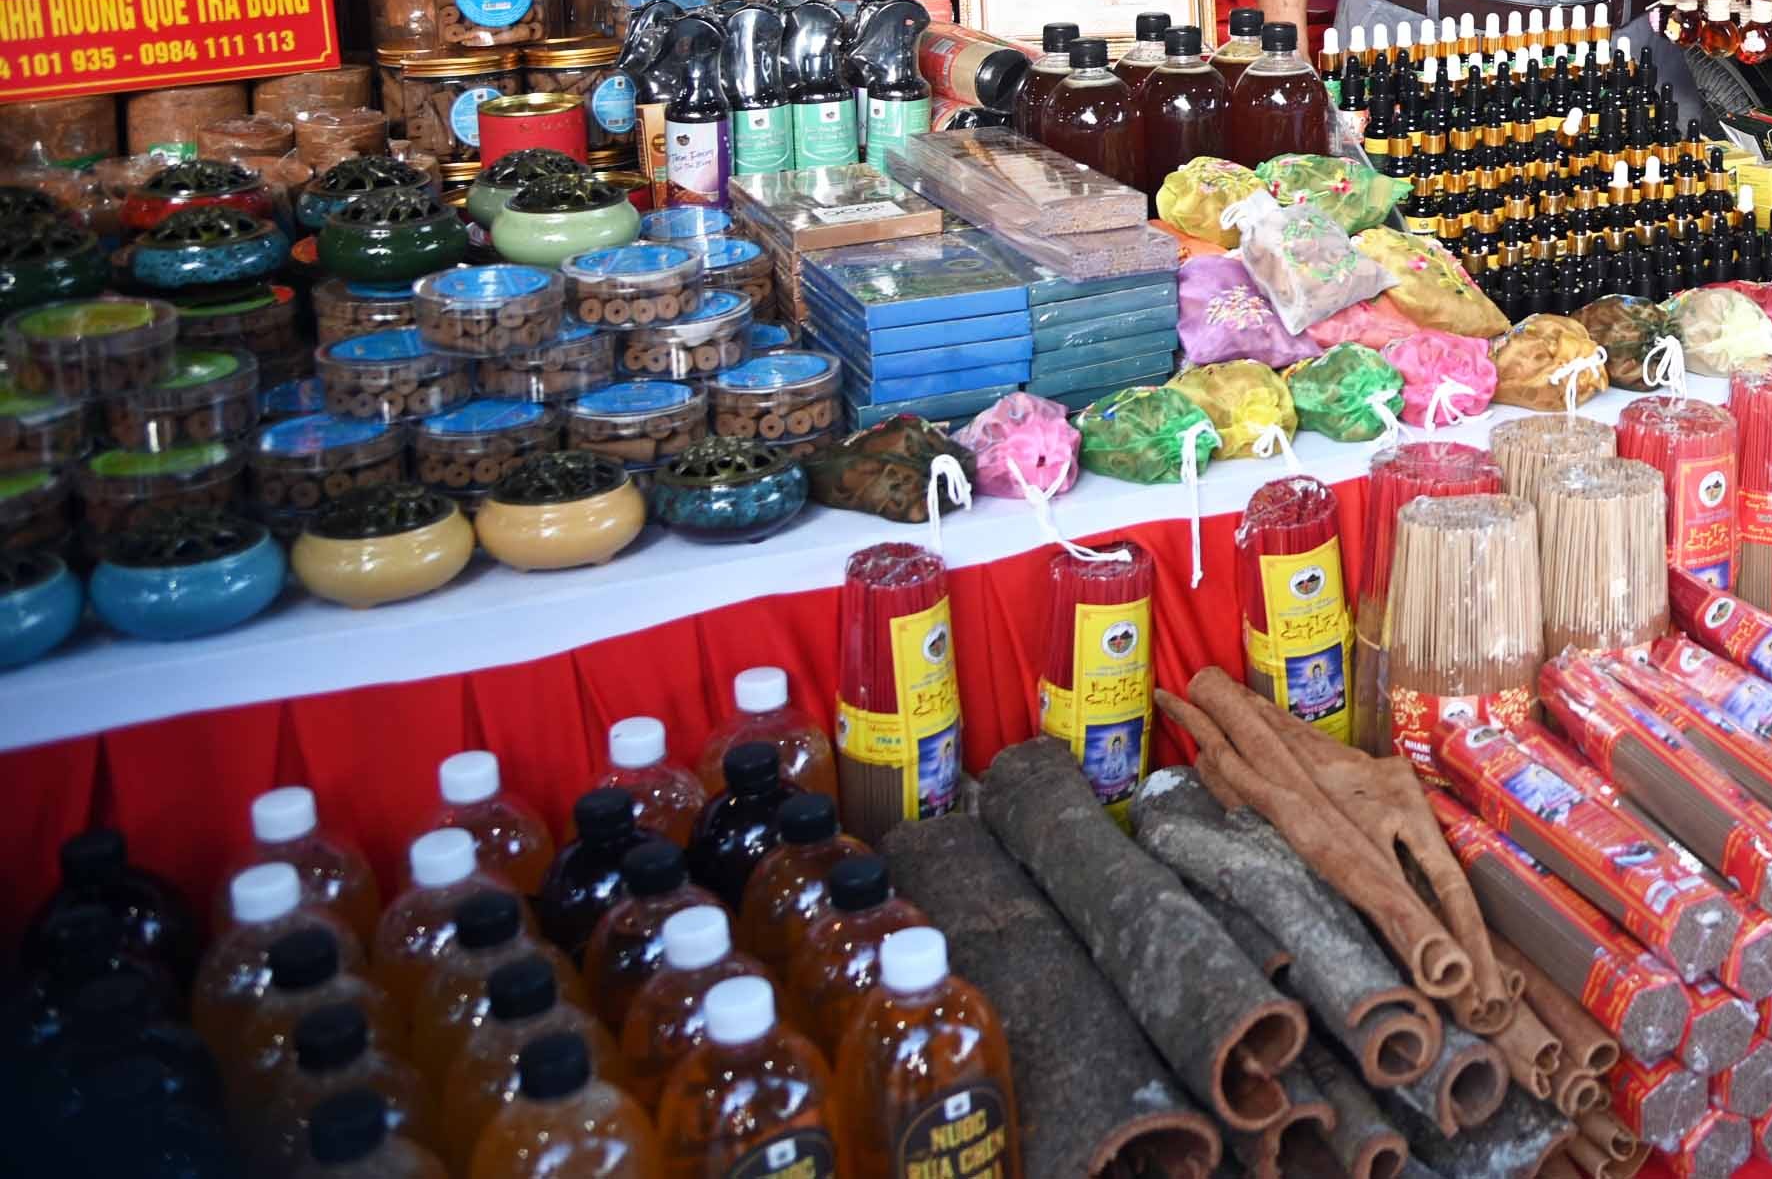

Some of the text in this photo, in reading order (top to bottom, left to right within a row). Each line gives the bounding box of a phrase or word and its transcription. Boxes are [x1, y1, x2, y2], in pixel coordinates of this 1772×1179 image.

[19, 53, 62, 77] 101
[71, 47, 116, 72] 935
[139, 40, 198, 65] 0984
[204, 35, 244, 58] 111
[253, 31, 295, 53] 113
